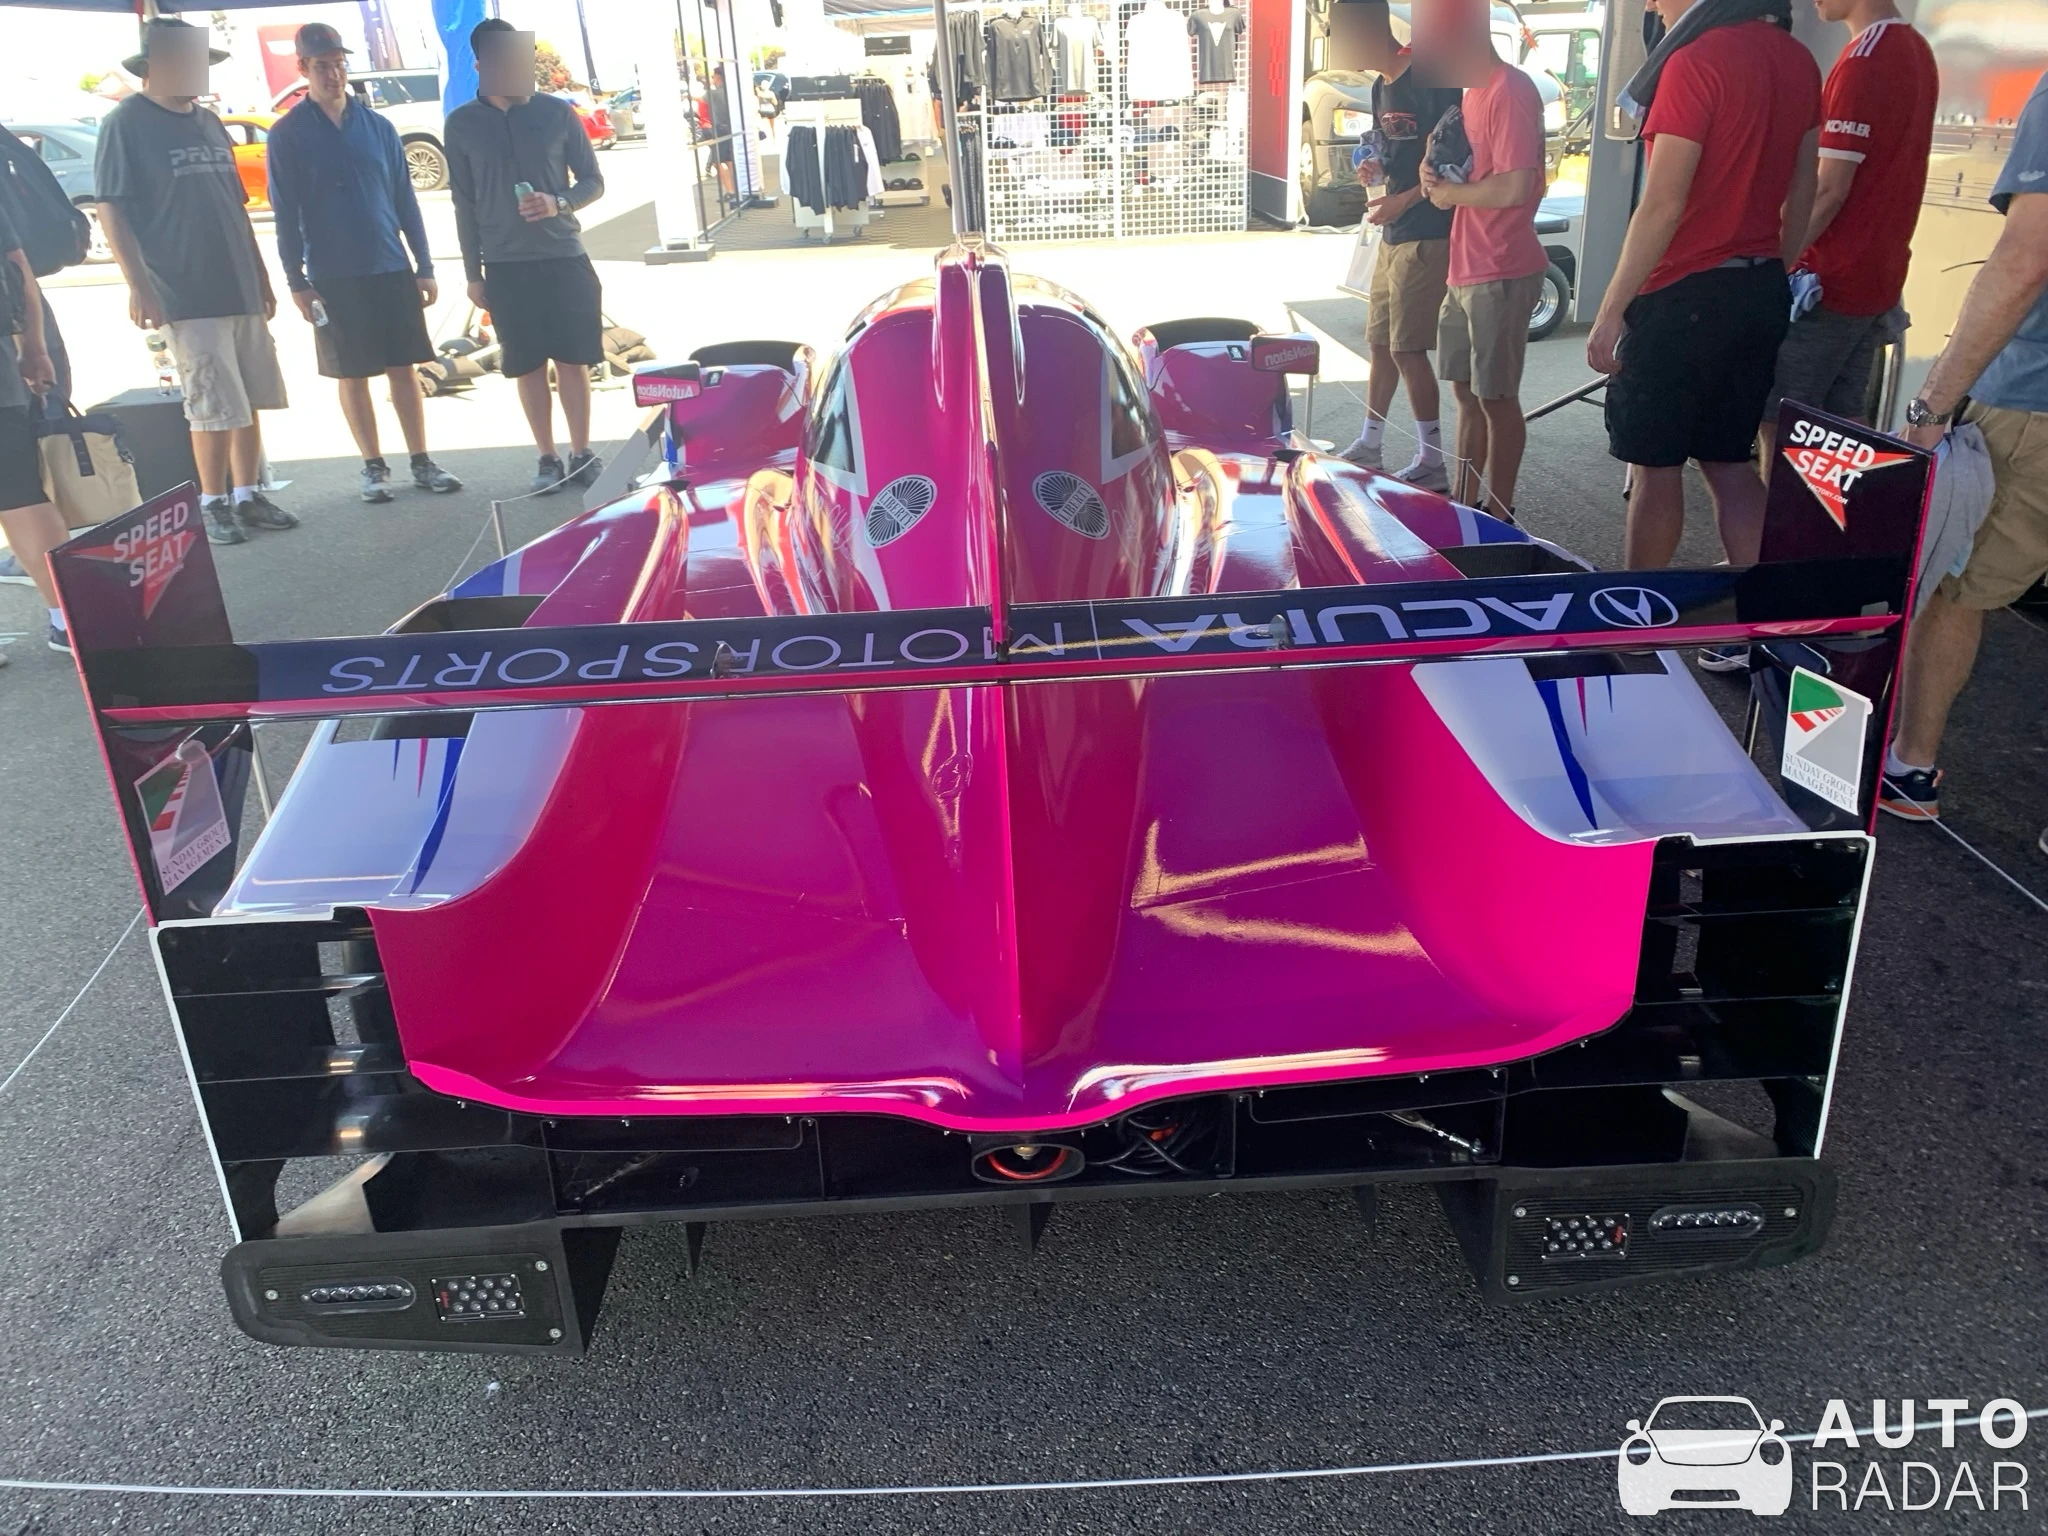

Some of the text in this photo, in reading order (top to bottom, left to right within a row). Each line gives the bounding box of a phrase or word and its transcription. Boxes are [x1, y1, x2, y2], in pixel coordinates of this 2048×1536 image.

[1823, 119, 1871, 138] KOHLER
[1789, 420, 1875, 468] SPEED
[1794, 450, 1863, 492] SEAT
[1807, 482, 1849, 505] FACTORY.COM
[879, 491, 913, 526] LIBERTY
[1058, 486, 1091, 522] LIBERTY
[113, 501, 189, 563] SPEED
[129, 530, 187, 587] SEAT
[322, 593, 1574, 693] ACURA MOTORSPORTS
[1784, 752, 1857, 798] SUNDAY GROUP
[1784, 763, 1854, 809] MANAGEMENT
